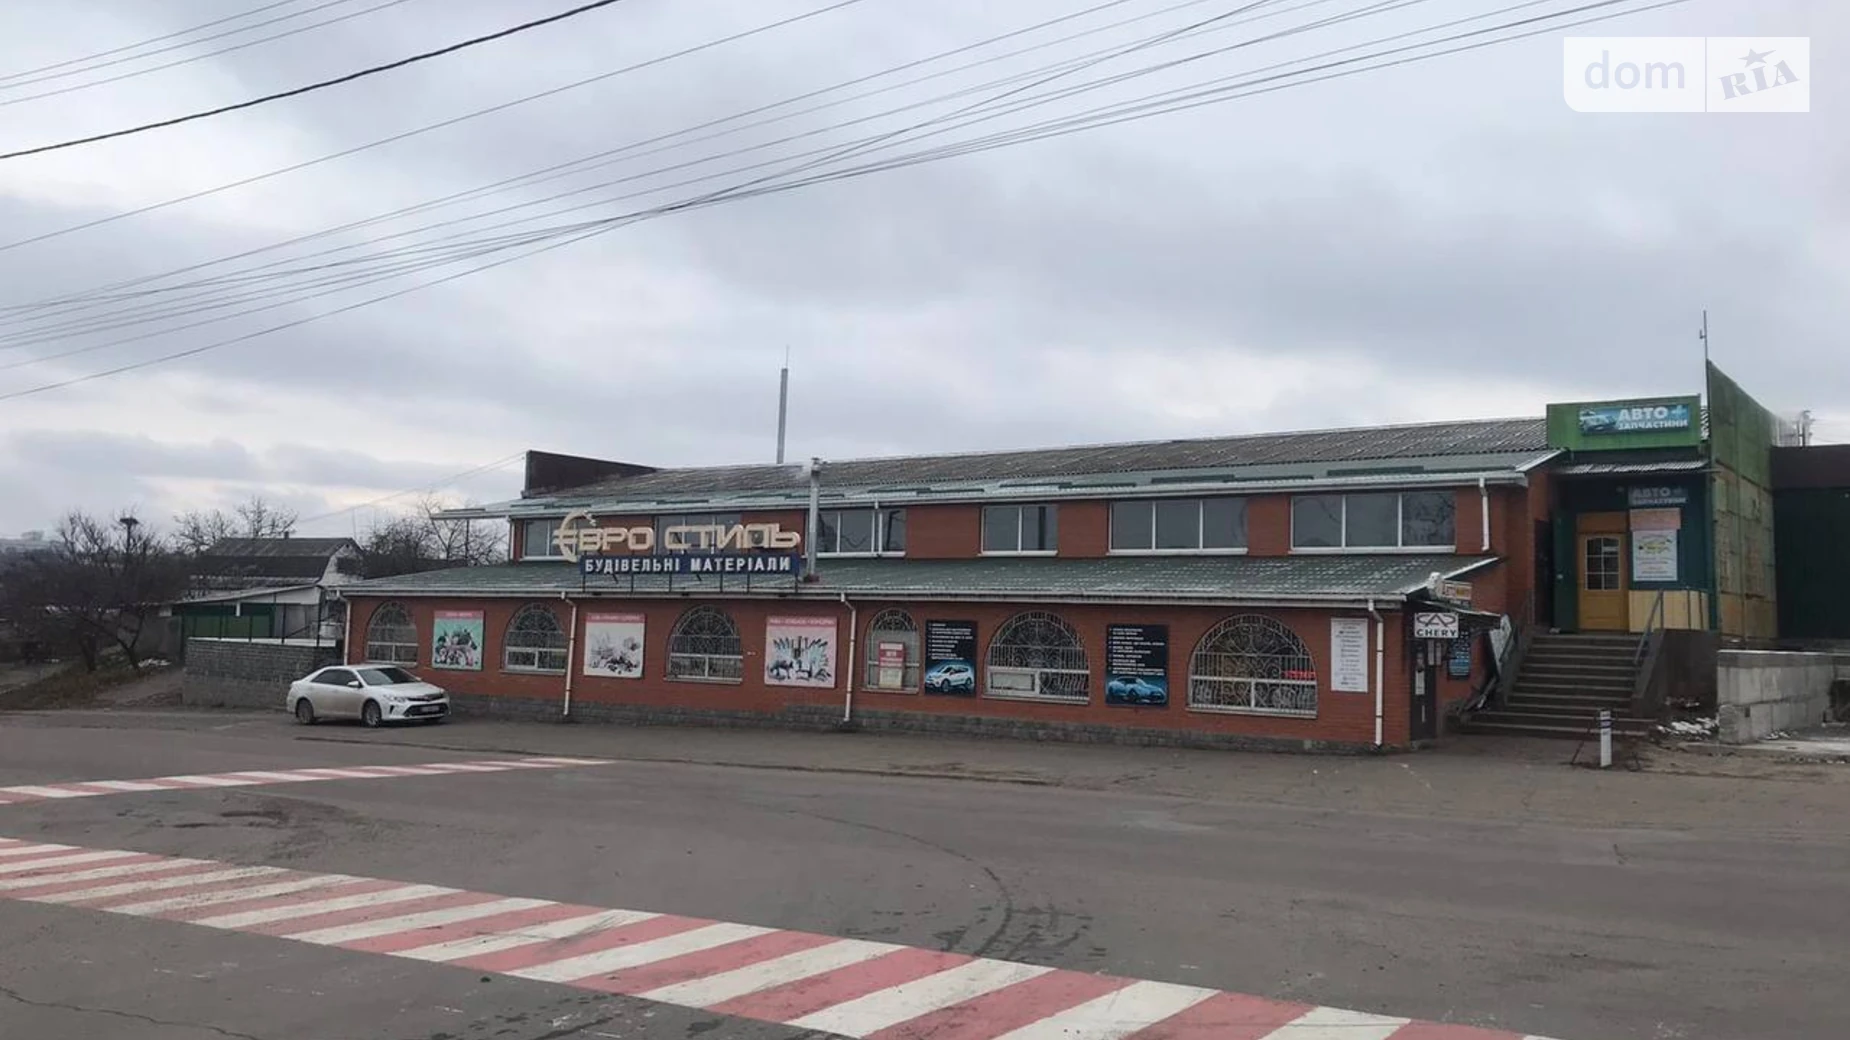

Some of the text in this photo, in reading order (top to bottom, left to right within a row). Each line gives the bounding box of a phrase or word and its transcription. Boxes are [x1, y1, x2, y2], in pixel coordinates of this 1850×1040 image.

[1619, 406, 1668, 421] АВТО
[1618, 420, 1688, 430] ЗАПЧАСТИНИ
[1633, 487, 1670, 498] АВТО
[664, 523, 801, 551] СТИЛЬ
[585, 556, 791, 574] БУДІВЕЛЬНІ МАТЕРІАЛИ
[1416, 629, 1457, 637] CHERY
